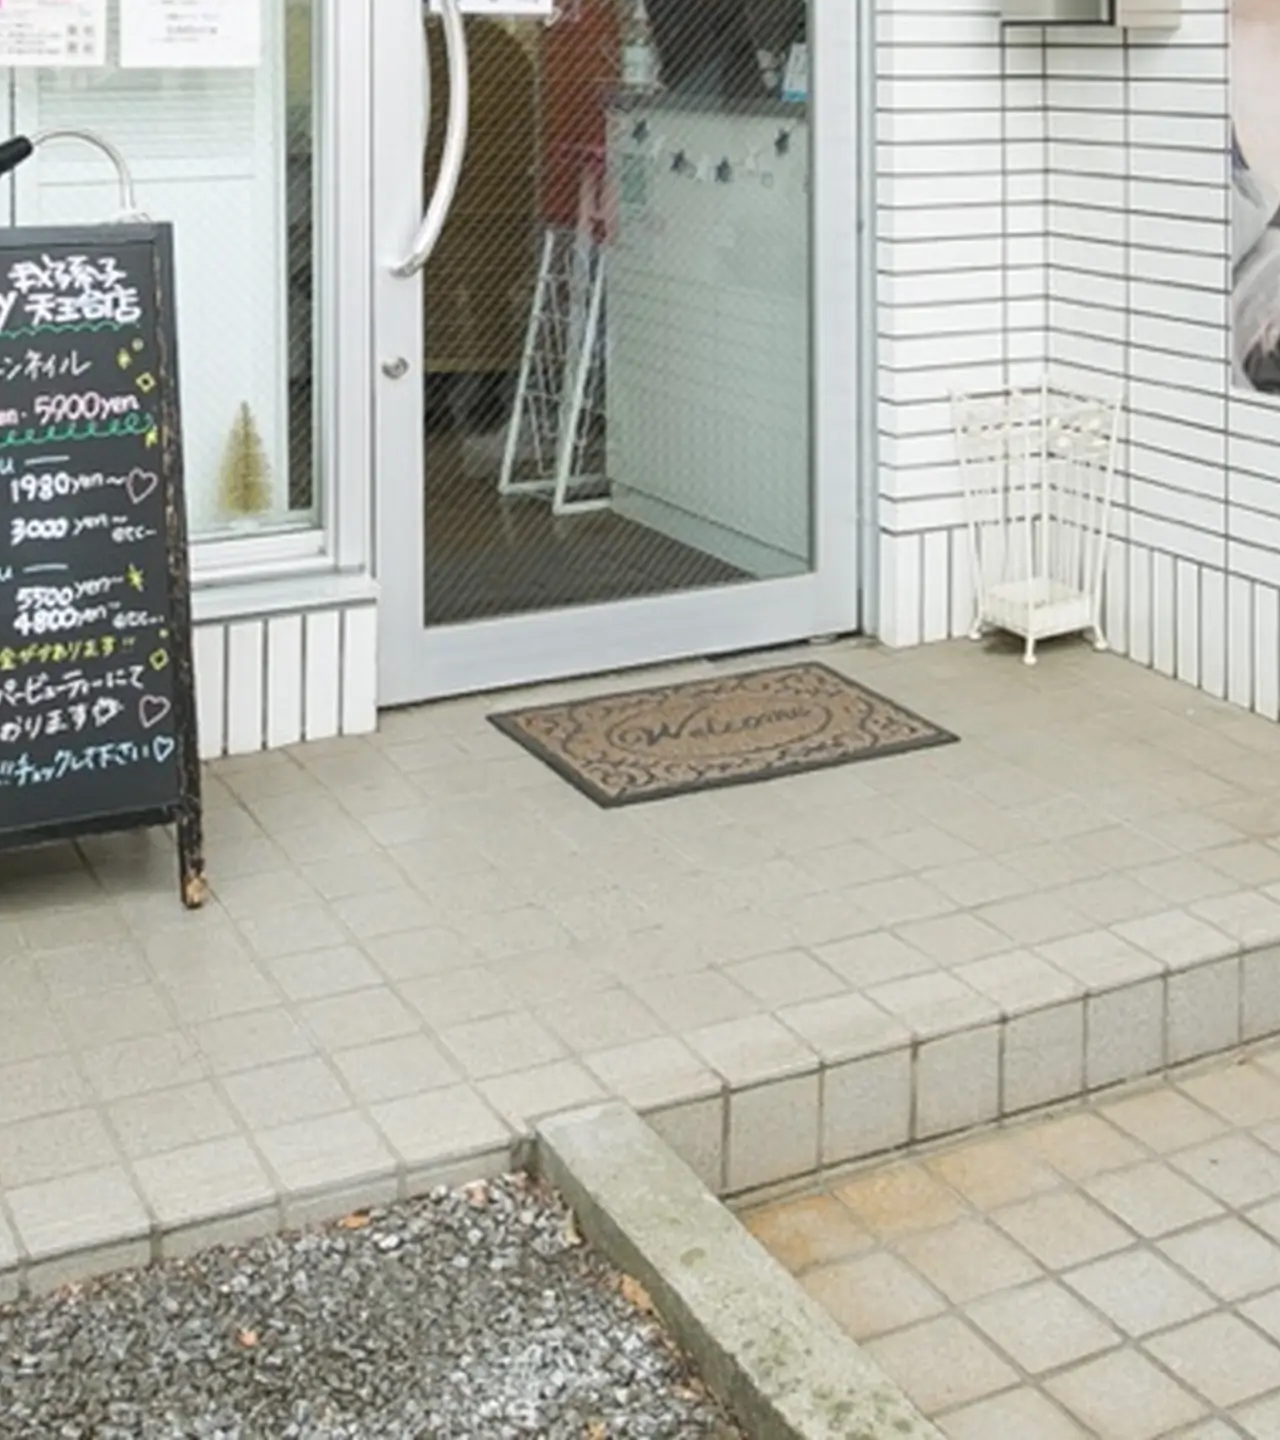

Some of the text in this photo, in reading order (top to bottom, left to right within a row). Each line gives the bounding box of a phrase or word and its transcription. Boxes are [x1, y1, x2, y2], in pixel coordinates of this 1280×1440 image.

[6, 253, 128, 295] 我孫子
[24, 283, 142, 326] 天王台店
